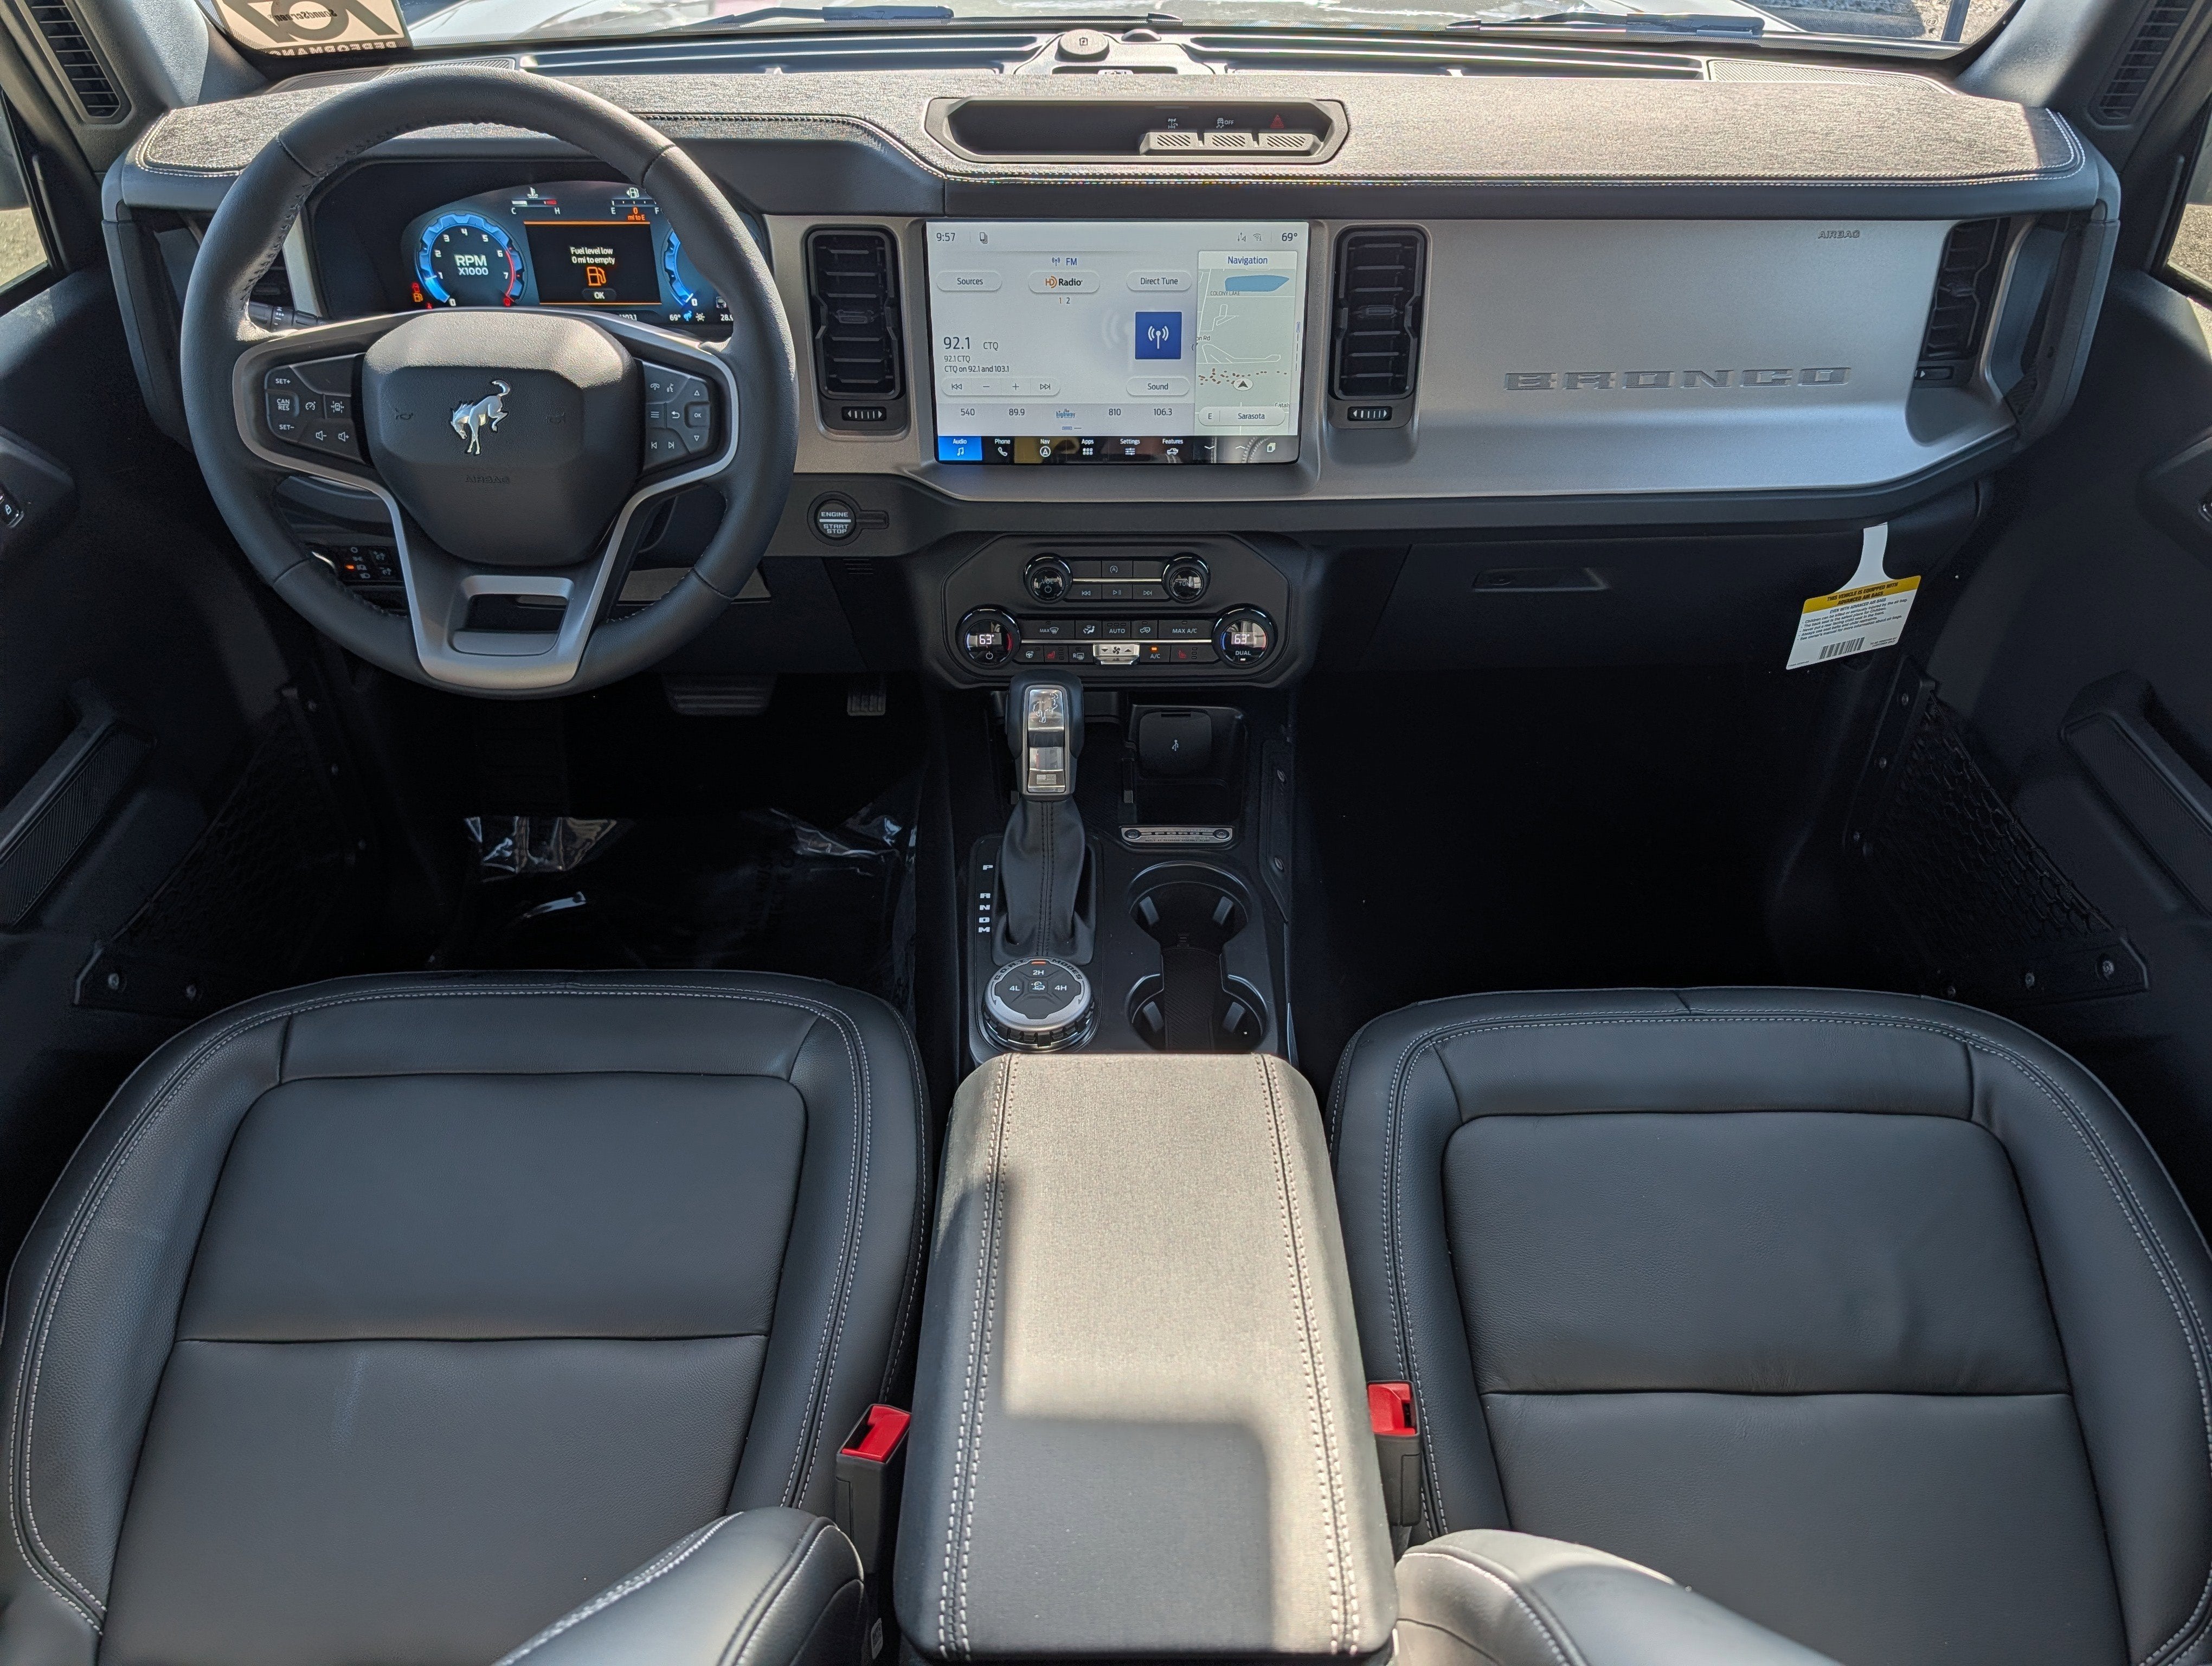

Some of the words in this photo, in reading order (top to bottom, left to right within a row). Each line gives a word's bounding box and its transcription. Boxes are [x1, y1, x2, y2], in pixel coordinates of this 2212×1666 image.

[443, 234, 450, 242] 3
[481, 234, 488, 242] 5
[936, 233, 955, 242] 9:57
[1281, 232, 1298, 242] 69°
[1818, 230, 1860, 239] AIRBAG
[434, 249, 442, 258] 2
[496, 249, 503, 258] 6
[570, 247, 584, 255] Fuel
[586, 247, 600, 255] level
[601, 247, 613, 255] low
[454, 254, 487, 266] RPM
[1066, 258, 1077, 266] FM
[1227, 256, 1268, 265] Navigation
[458, 267, 489, 275] X1000
[1140, 277, 1160, 285] Direct
[1161, 277, 1178, 285] Tune
[449, 298, 456, 306] 0
[691, 298, 698, 306] 0
[943, 337, 970, 350] 92.1
[983, 342, 999, 351] CTQ
[957, 355, 970, 363] CTQ
[1504, 367, 1851, 390] BRONCO
[465, 475, 510, 484] AIRBAG
[1051, 958, 1083, 979] MODES
